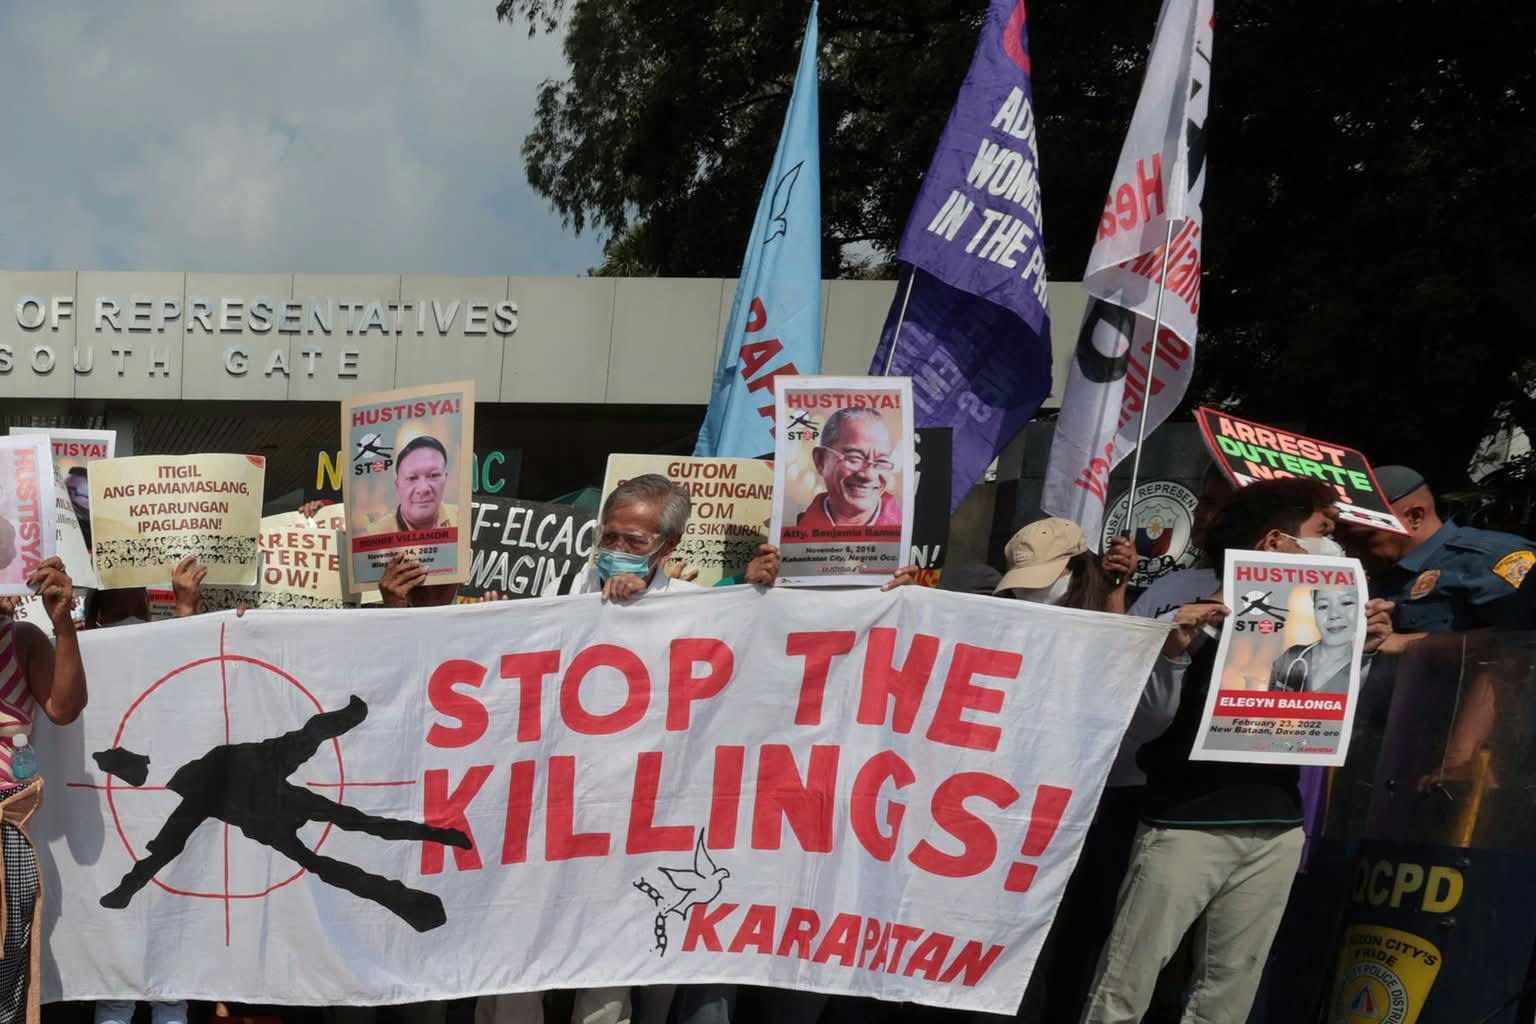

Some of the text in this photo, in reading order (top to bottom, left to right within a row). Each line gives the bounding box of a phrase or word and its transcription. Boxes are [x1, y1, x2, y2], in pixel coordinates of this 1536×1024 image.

[928, 191, 1033, 269] IN THE
[16, 297, 75, 331] OF
[95, 297, 520, 336] REPRESENTATIVES
[224, 347, 361, 378] GATE
[787, 394, 902, 409] HUSTISYA!
[352, 399, 461, 427] HUSTISYA!
[1219, 417, 1345, 467] ARREST
[158, 464, 201, 479] ITIGIL
[667, 462, 737, 480] GUTOM
[1215, 435, 1373, 492] DUTERTE
[103, 481, 250, 499] ANG PAMAMASLANG,
[129, 501, 228, 517] KATARUNGAN
[138, 518, 222, 534] IPAGLABAN!
[1236, 566, 1355, 585] HUSTISYA!
[1235, 620, 1284, 634] STOP
[425, 627, 1023, 752] STOP THE
[1219, 697, 1342, 711] ELEGYN BALONGA
[1232, 719, 1322, 729] February 23, 2022
[419, 742, 1072, 894] KILLINGS!
[682, 903, 1004, 988] KARAPATAN
